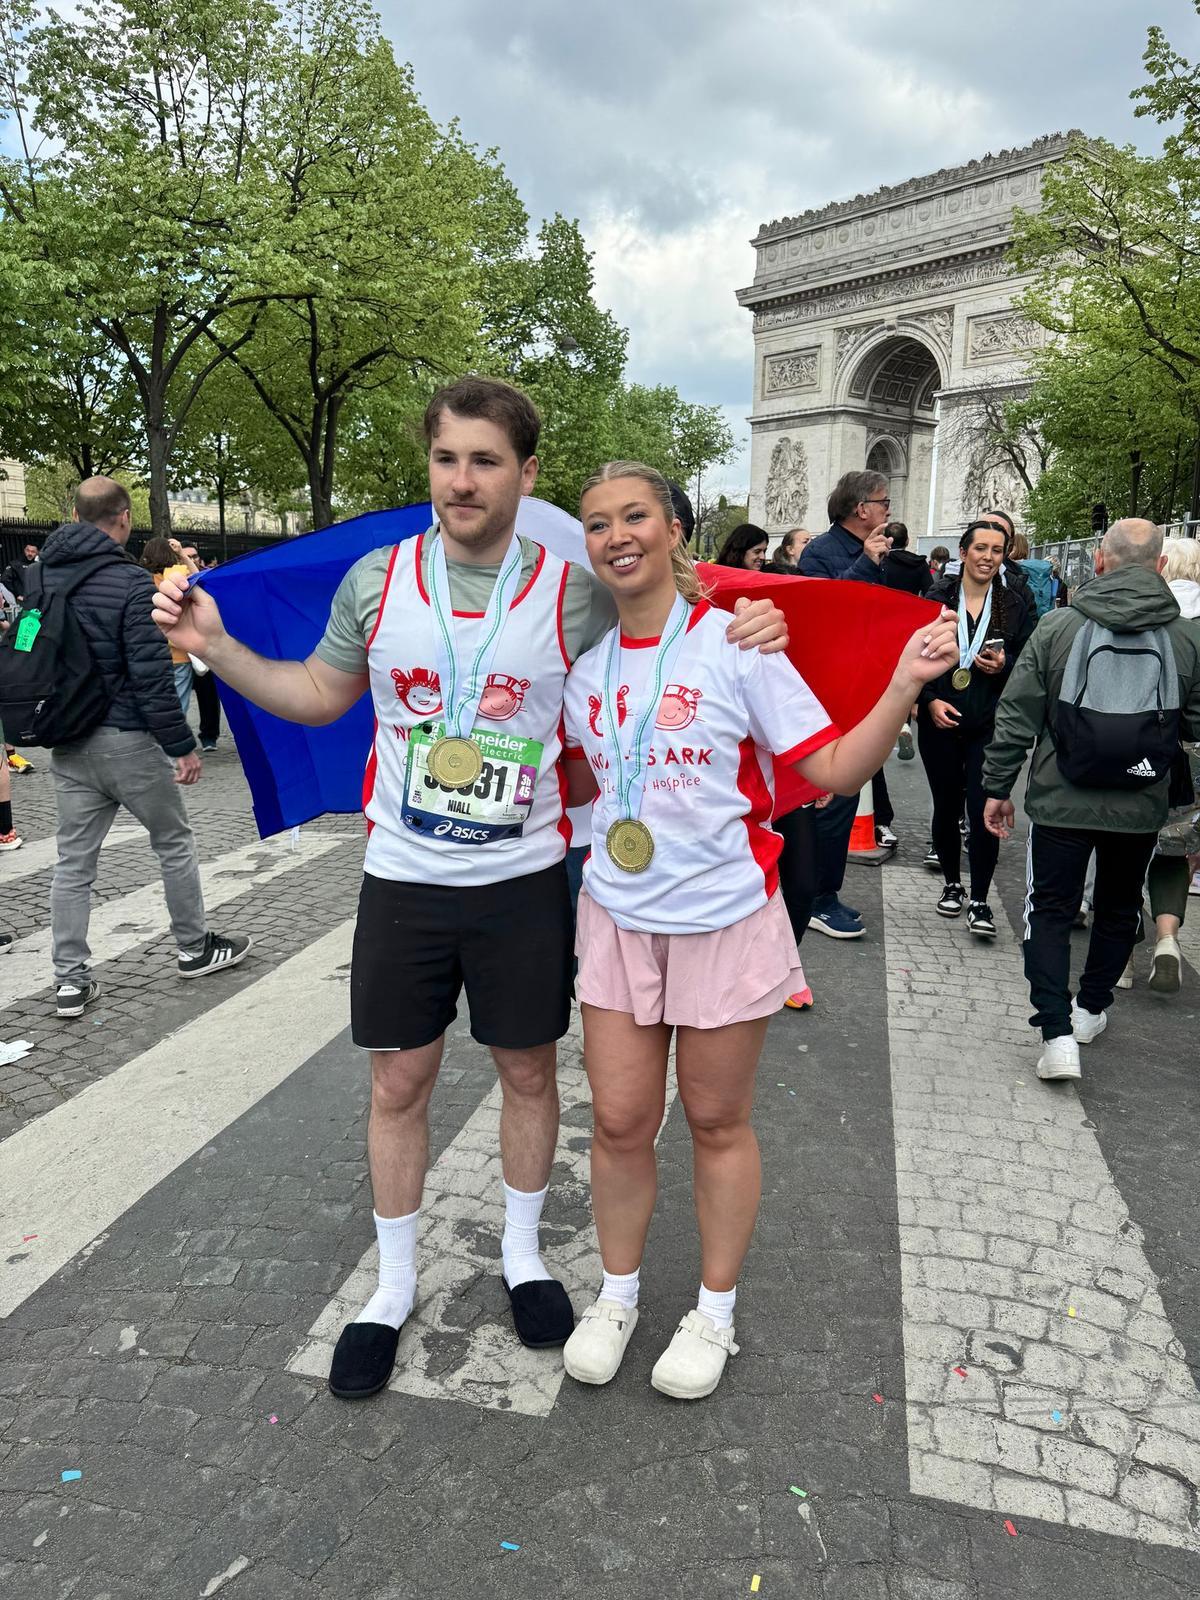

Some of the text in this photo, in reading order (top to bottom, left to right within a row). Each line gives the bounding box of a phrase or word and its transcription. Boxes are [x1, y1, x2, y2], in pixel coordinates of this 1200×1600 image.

[471, 732, 527, 752] neider
[480, 744, 523, 761] Electric
[664, 747, 714, 766] ARK
[521, 774, 532, 786] 3h
[1126, 768, 1156, 777] adidas
[652, 772, 701, 792] Hospice
[519, 786, 531, 799] 45
[447, 799, 471, 816] NIALL
